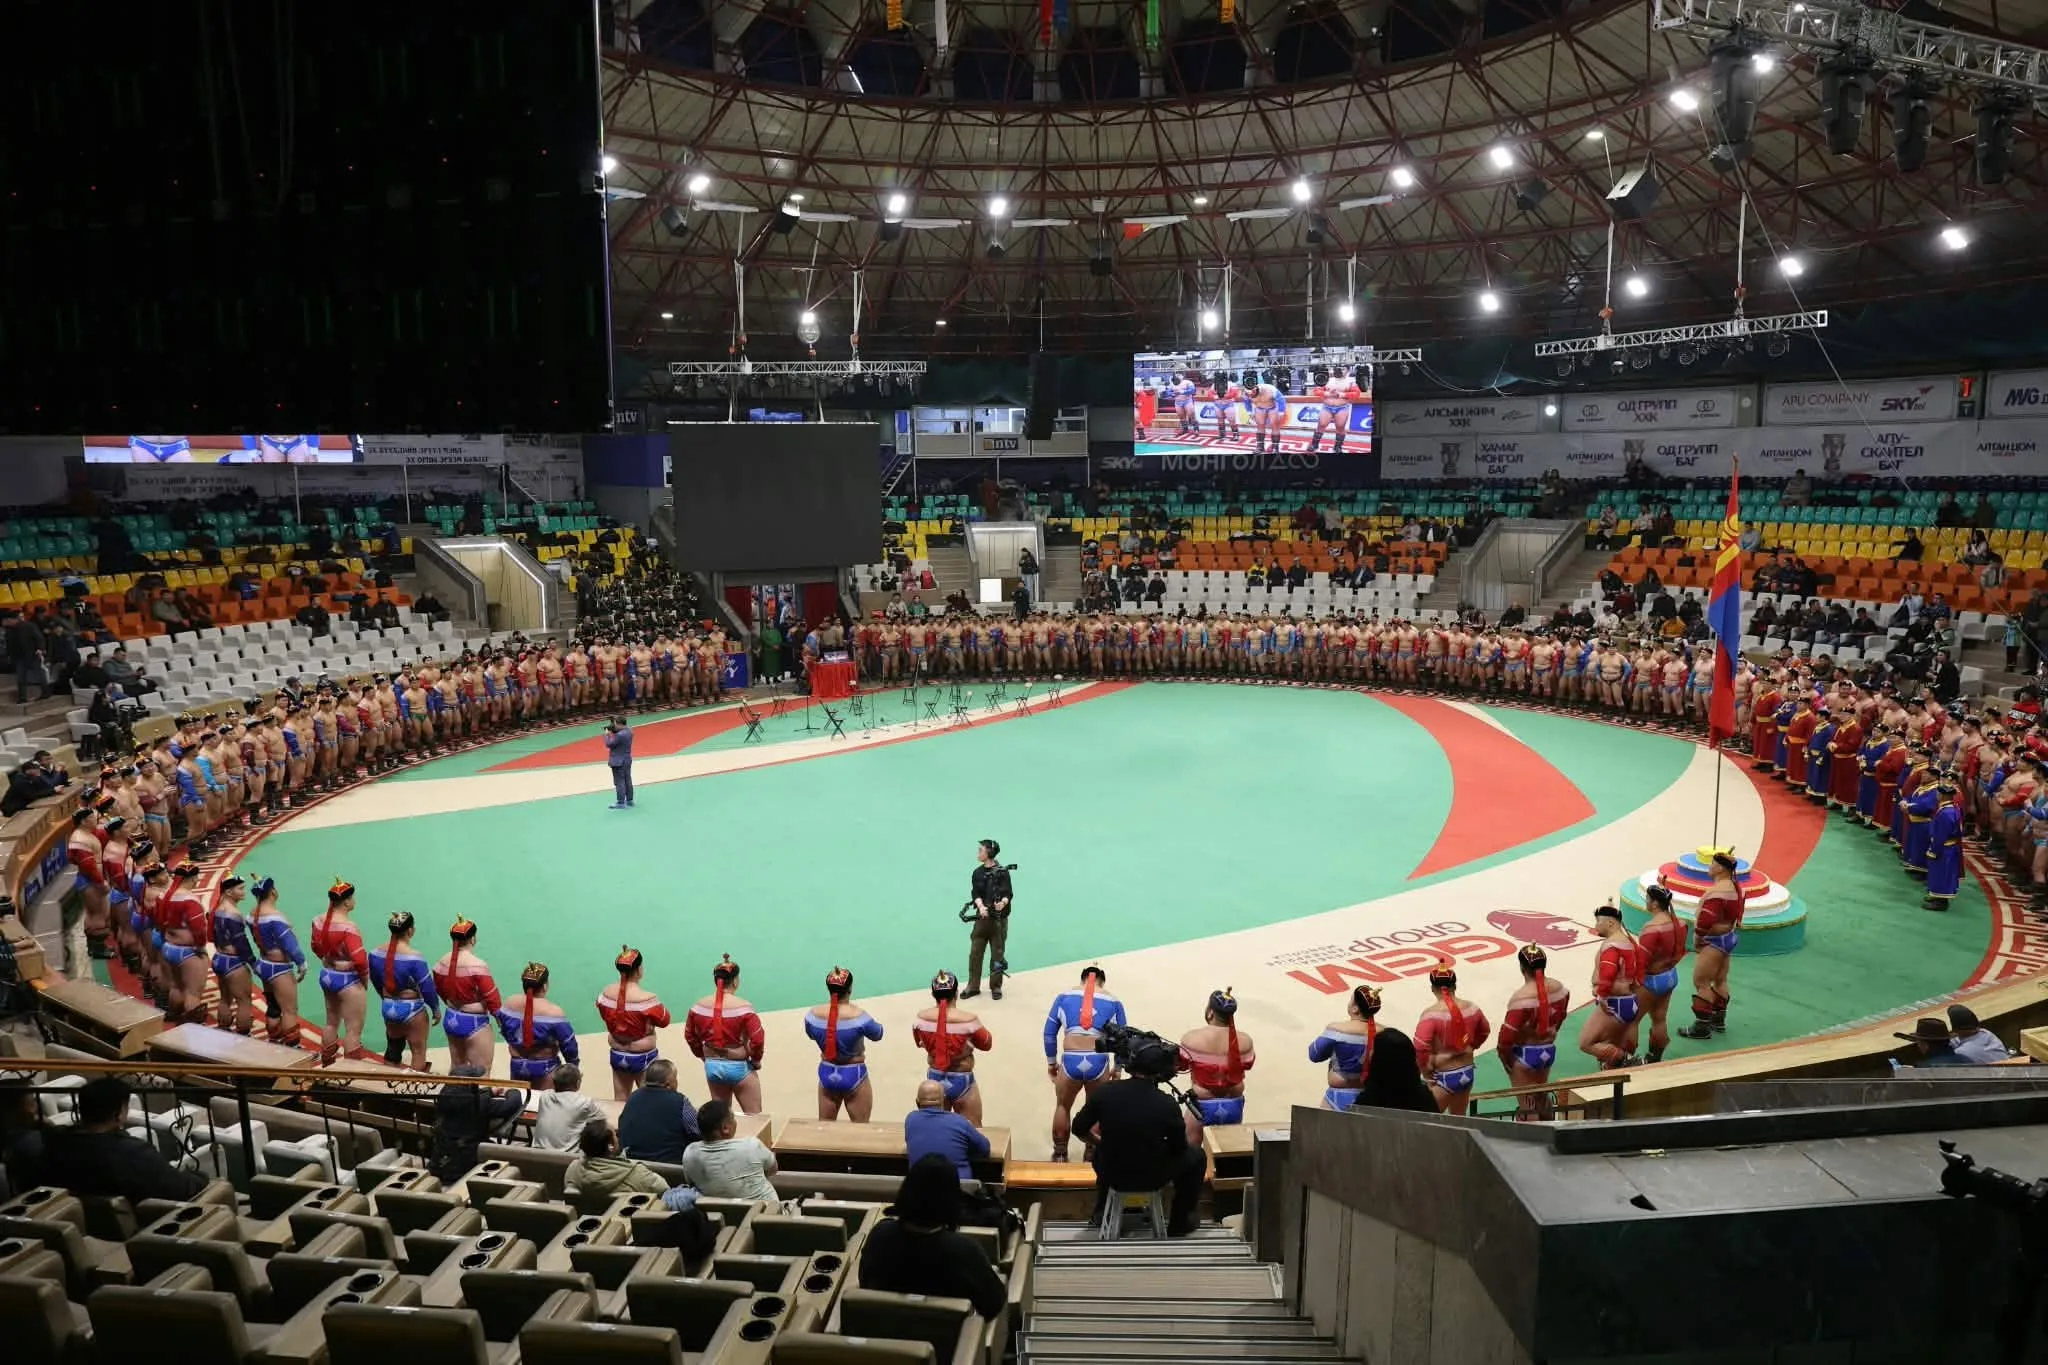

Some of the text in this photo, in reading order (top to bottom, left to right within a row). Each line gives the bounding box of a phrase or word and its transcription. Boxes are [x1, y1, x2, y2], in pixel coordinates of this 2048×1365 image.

[1782, 391, 1871, 406] APU COMPANY
[1617, 399, 1677, 412] ОД ГРУПП
[995, 438, 1017, 449] ntv
[1656, 443, 1719, 456] ОД ГРУПП
[1475, 453, 1524, 464] МОНГОЛ
[1676, 456, 1700, 467] БАГ
[1488, 464, 1509, 475] БАГ
[1350, 921, 1471, 953] GROUP
